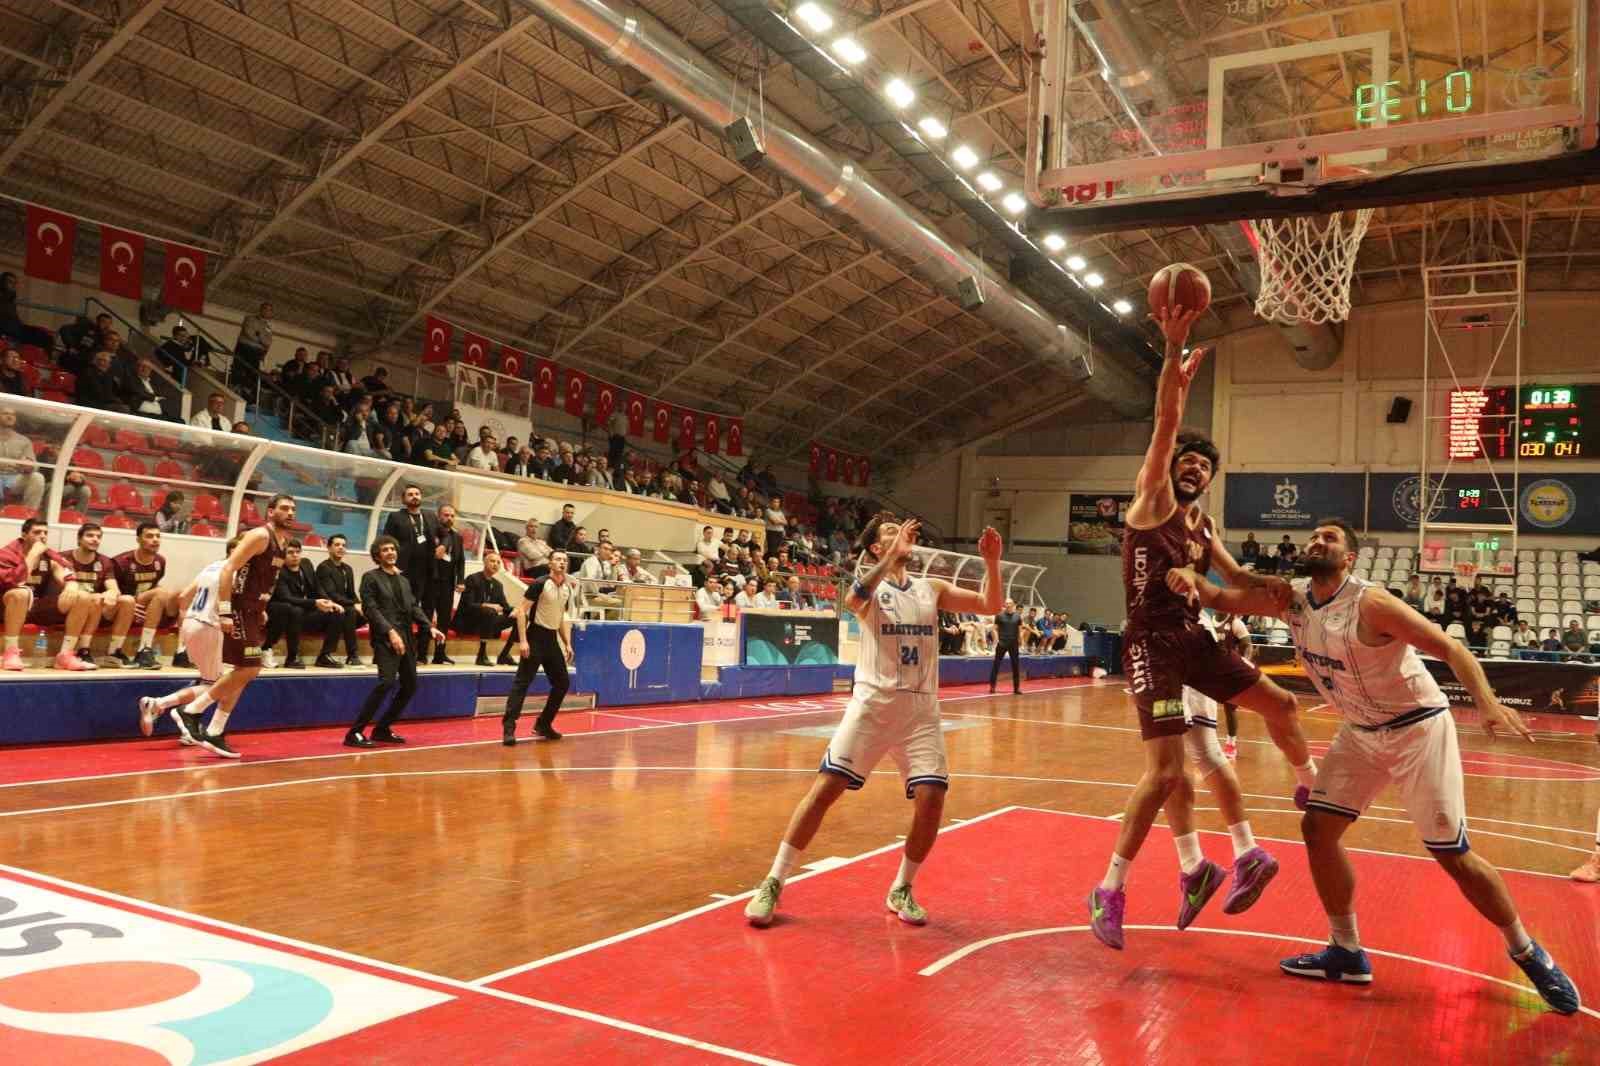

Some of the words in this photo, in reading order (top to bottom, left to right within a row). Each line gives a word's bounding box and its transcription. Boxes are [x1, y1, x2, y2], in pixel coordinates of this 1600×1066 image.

[1520, 442, 1546, 456] 030
[1554, 442, 1581, 456] 041
[1460, 497, 1481, 508] 24
[901, 646, 919, 665] 24
